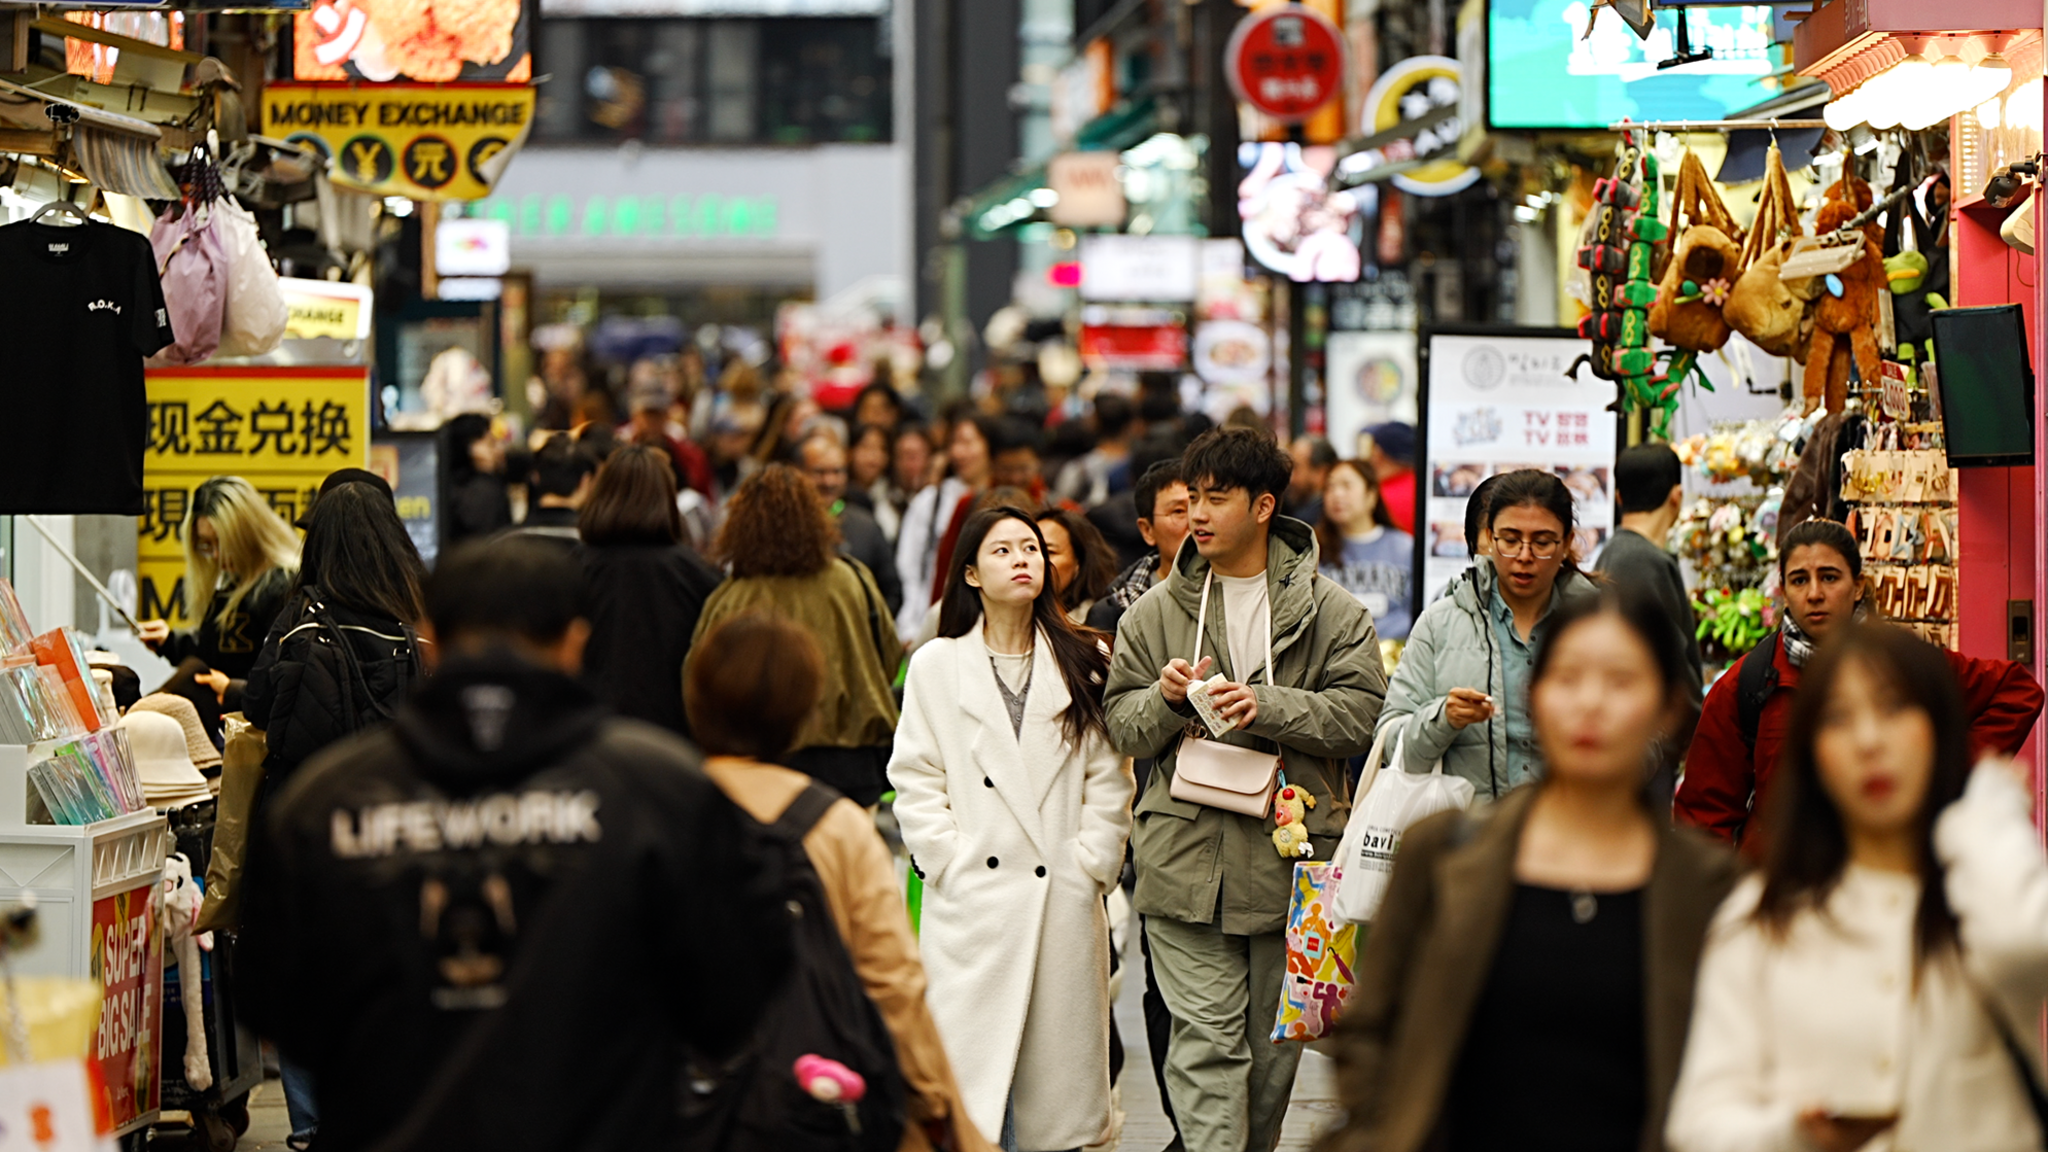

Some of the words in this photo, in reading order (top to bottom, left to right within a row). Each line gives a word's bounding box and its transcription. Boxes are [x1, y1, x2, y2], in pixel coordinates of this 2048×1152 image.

[271, 102, 370, 127] MONEY
[379, 101, 524, 128] EXCHANGE
[145, 400, 351, 456] 现金兑换
[1523, 410, 1550, 427] TV
[1523, 429, 1550, 446] TV
[330, 788, 603, 859] LIFEWORK
[105, 914, 147, 988] SUPER
[97, 993, 119, 1061] BIG
[119, 983, 153, 1053] SALE
